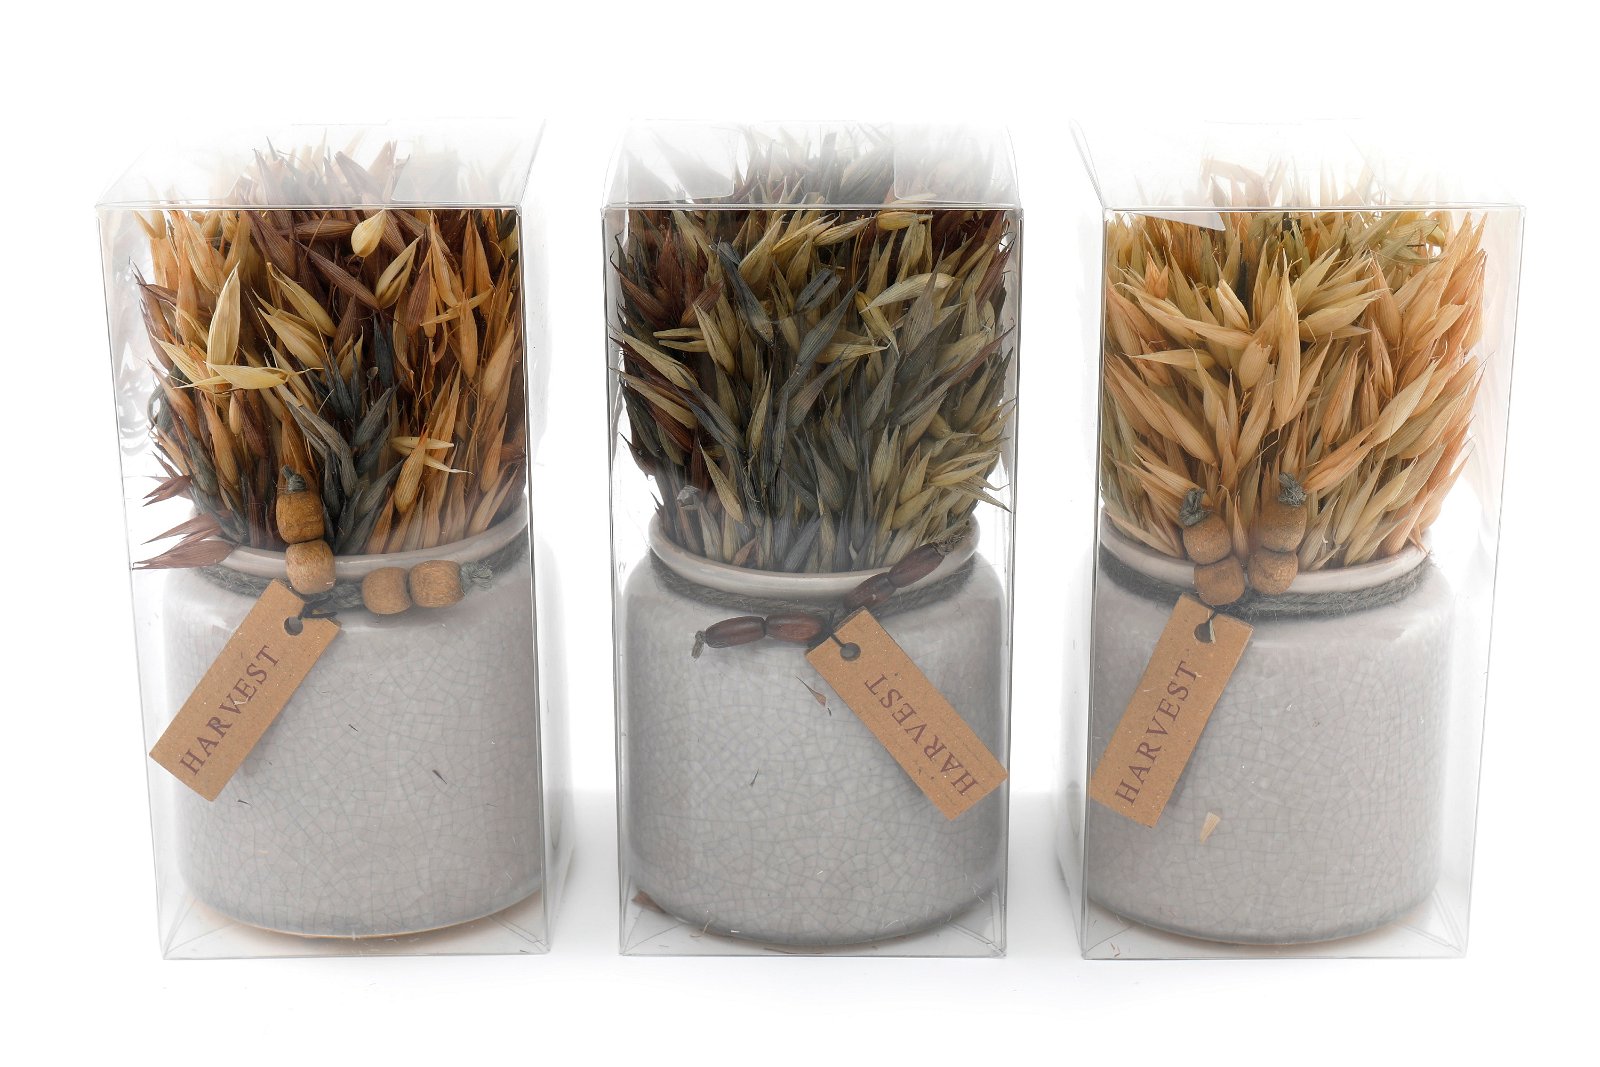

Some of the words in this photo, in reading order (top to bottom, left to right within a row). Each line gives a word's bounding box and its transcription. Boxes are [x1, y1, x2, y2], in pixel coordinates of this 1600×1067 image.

[179, 645, 280, 776] HARVEST
[864, 674, 978, 796] HARVEST
[1115, 660, 1198, 805] HARVEST
